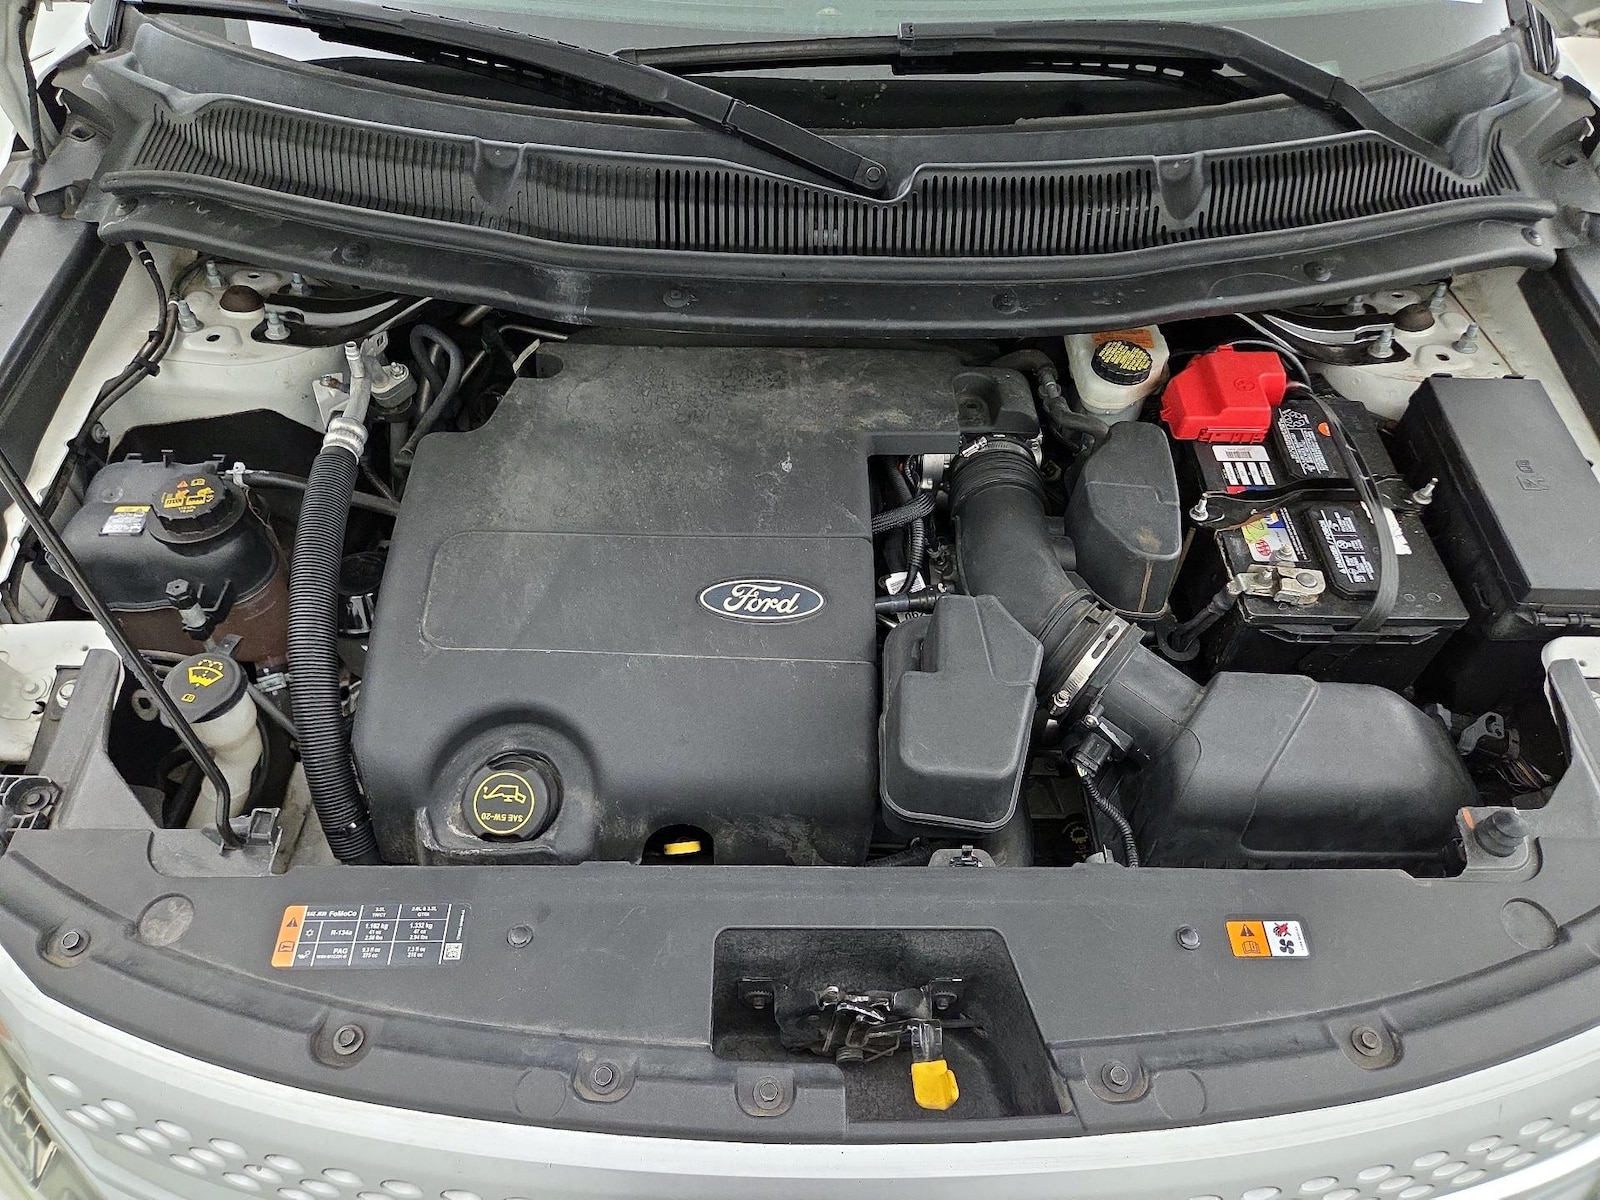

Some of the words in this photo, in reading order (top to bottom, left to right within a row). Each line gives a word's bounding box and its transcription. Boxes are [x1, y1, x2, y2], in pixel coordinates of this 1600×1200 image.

[723, 583, 801, 613] Ford
[481, 812, 507, 821] 5W-20
[508, 813, 523, 822] SAE
